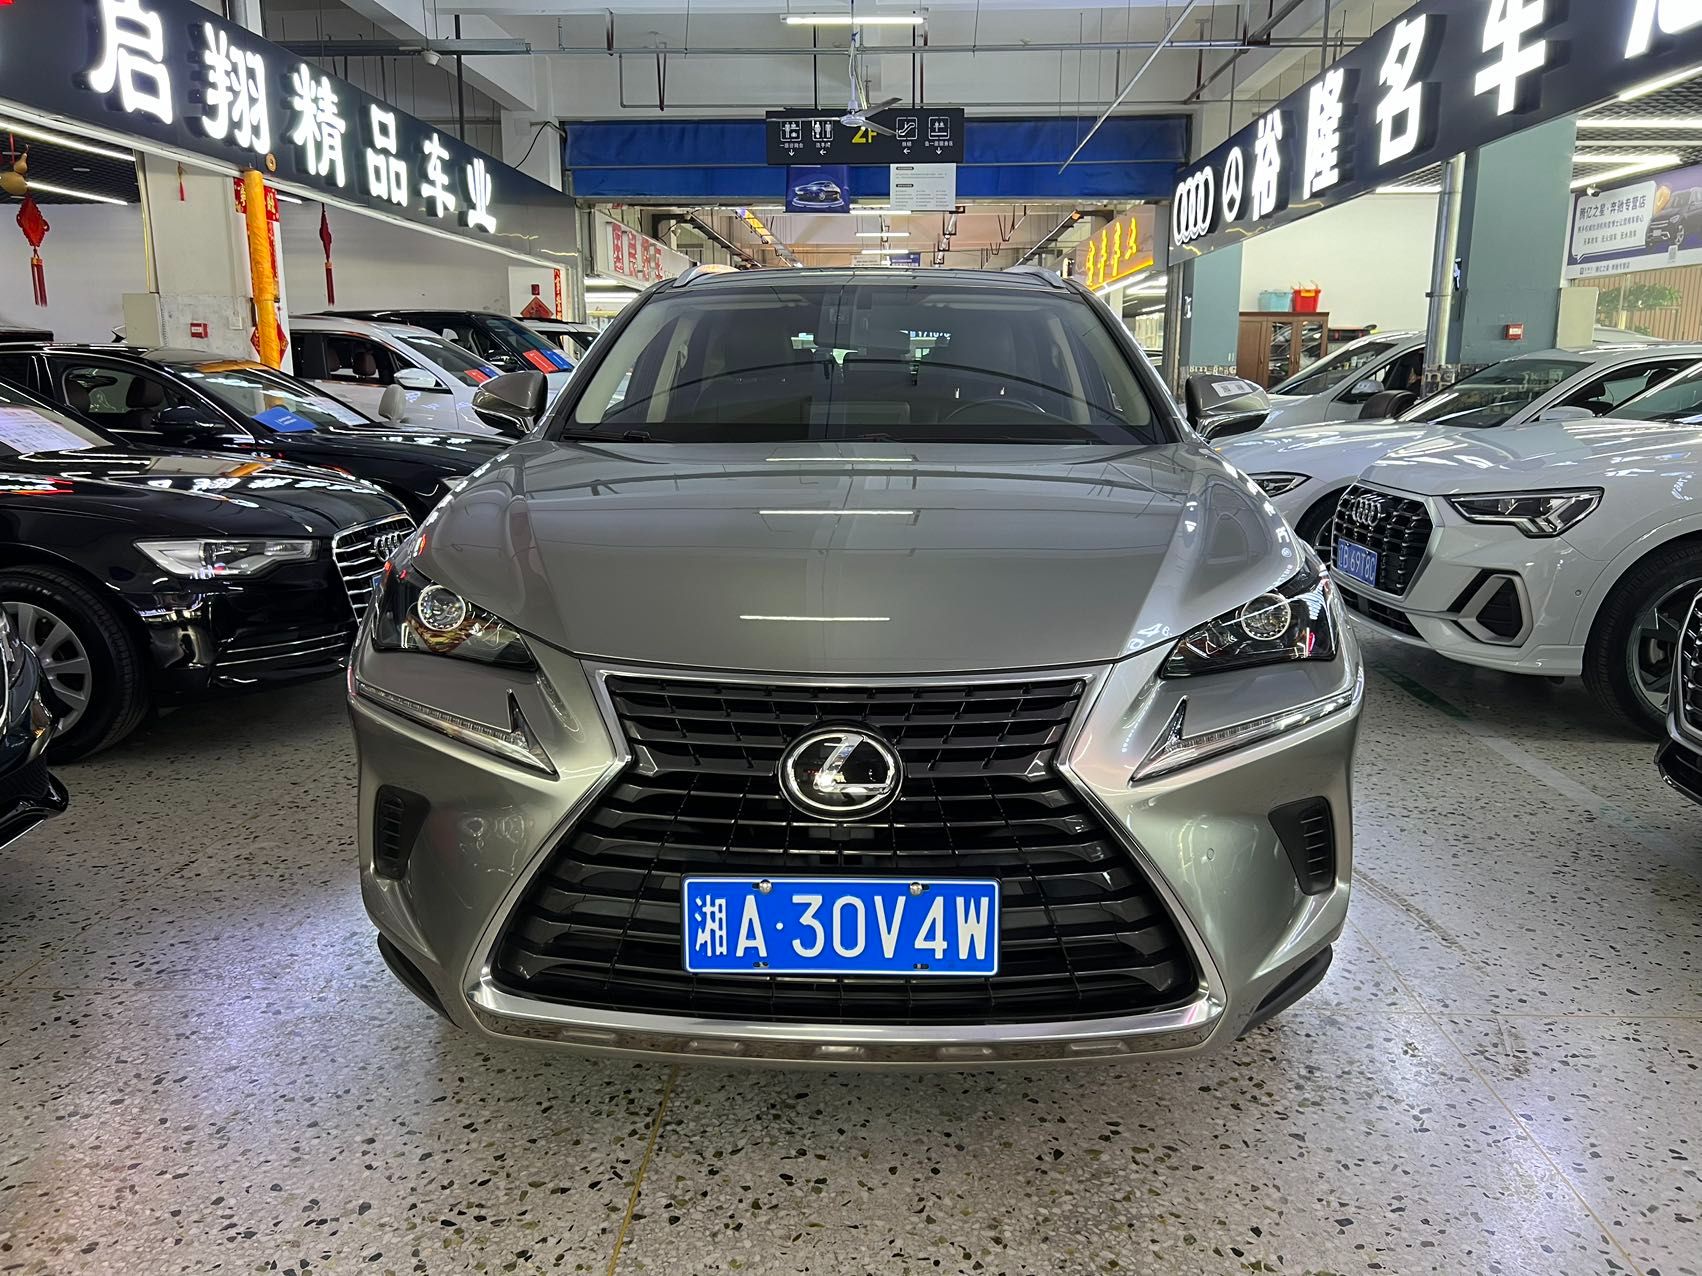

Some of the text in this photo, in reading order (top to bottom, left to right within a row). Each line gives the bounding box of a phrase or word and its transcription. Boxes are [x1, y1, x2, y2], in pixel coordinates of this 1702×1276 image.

[89, 0, 497, 234] 启翔精品车业
[695, 894, 989, 959] 湘A·30V4W
